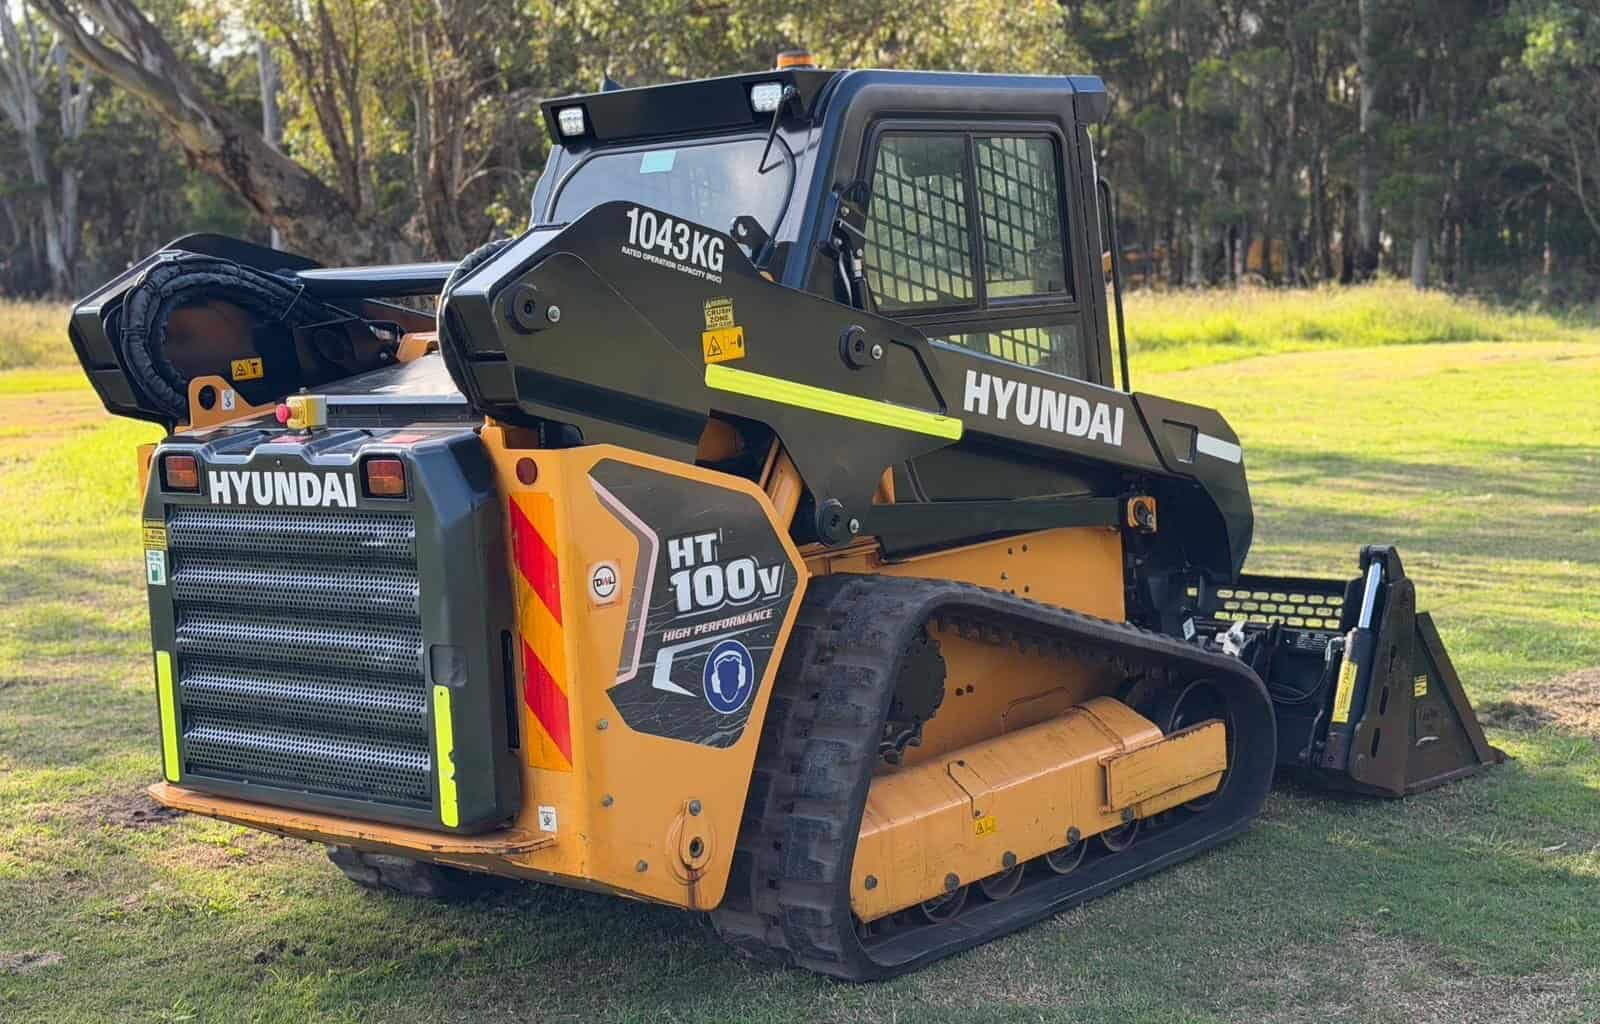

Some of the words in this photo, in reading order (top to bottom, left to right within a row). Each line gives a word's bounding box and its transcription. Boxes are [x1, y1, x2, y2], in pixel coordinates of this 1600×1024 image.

[621, 245, 642, 259] RATED
[642, 252, 677, 270] OPERATION
[676, 263, 706, 279] CAPACITY
[706, 308, 731, 317] CRUSH
[710, 314, 729, 323] ZONE
[963, 369, 1125, 447] HYUNDAI
[208, 471, 358, 508] HYUNDAI
[668, 532, 718, 570] HT
[662, 627, 692, 643] HIGH
[693, 607, 774, 636] PERFORMANCE
